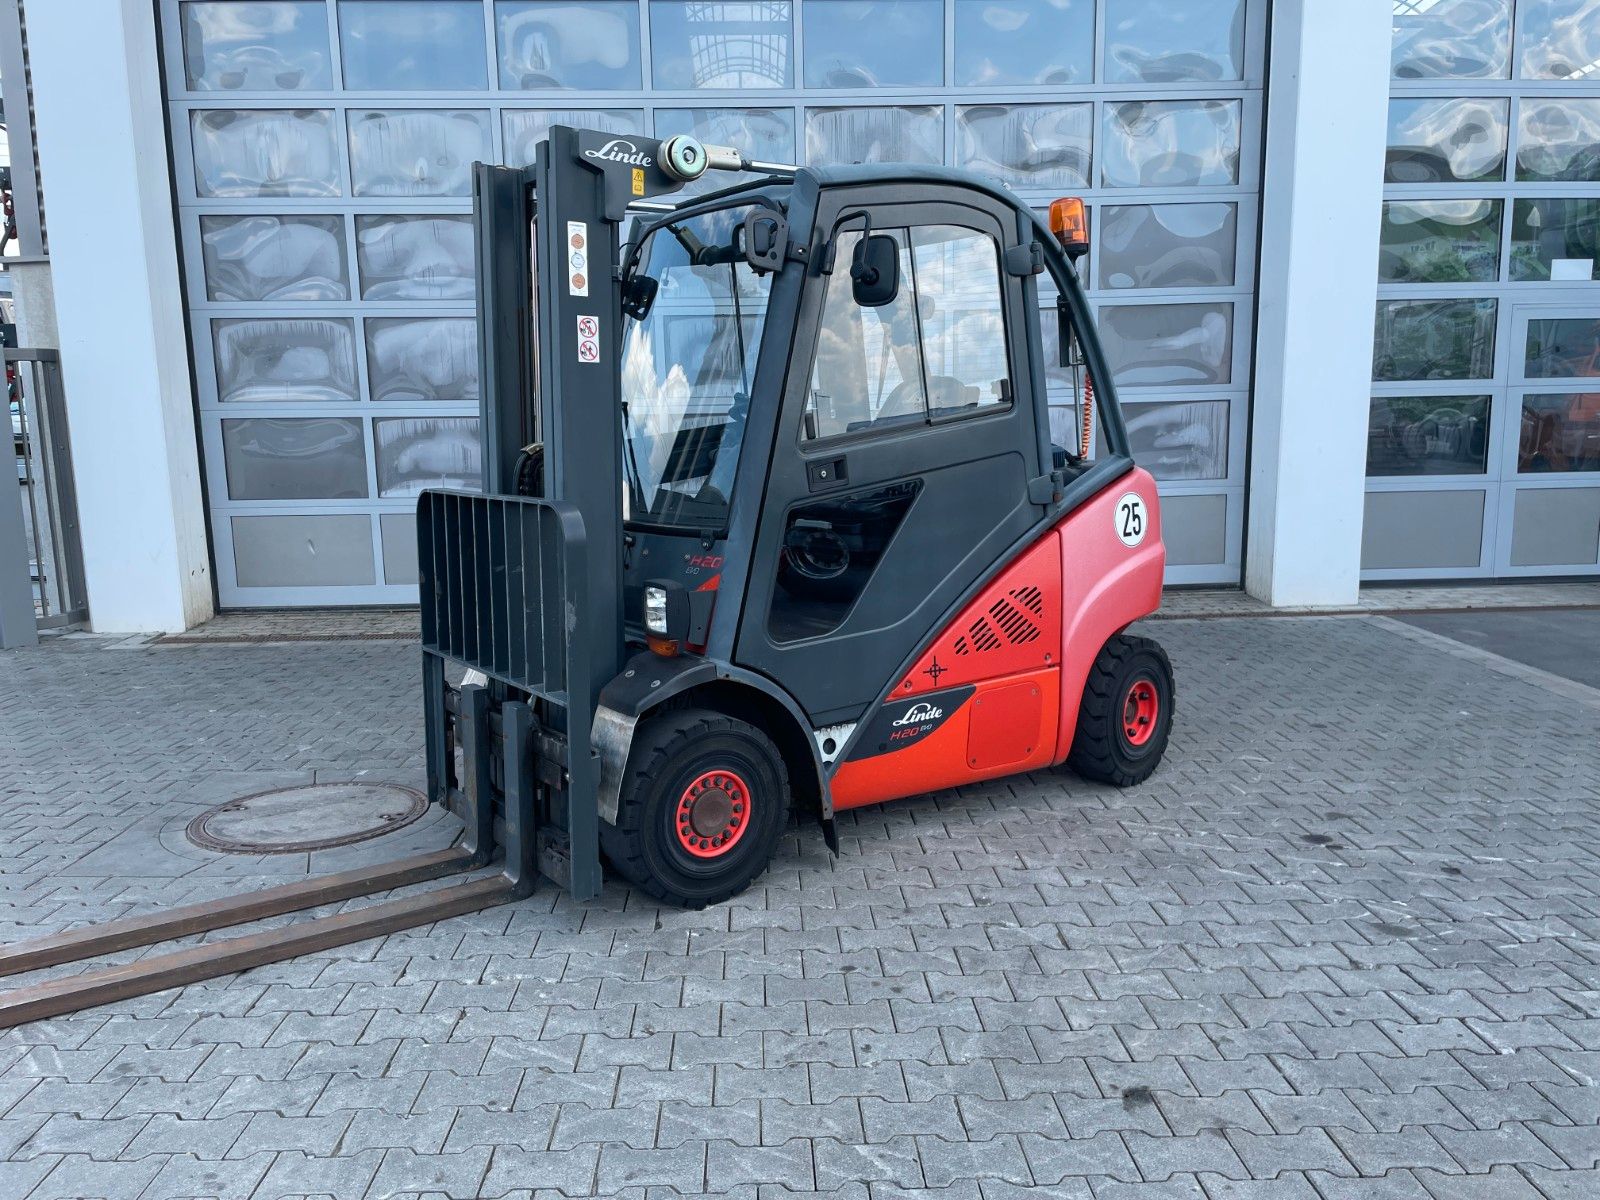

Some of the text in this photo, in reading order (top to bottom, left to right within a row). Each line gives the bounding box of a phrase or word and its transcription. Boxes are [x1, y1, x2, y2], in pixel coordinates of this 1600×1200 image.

[584, 140, 652, 167] Linde
[1121, 502, 1142, 538] 25
[690, 555, 723, 568] H20
[892, 702, 943, 727] Linde
[890, 727, 920, 740] H20
